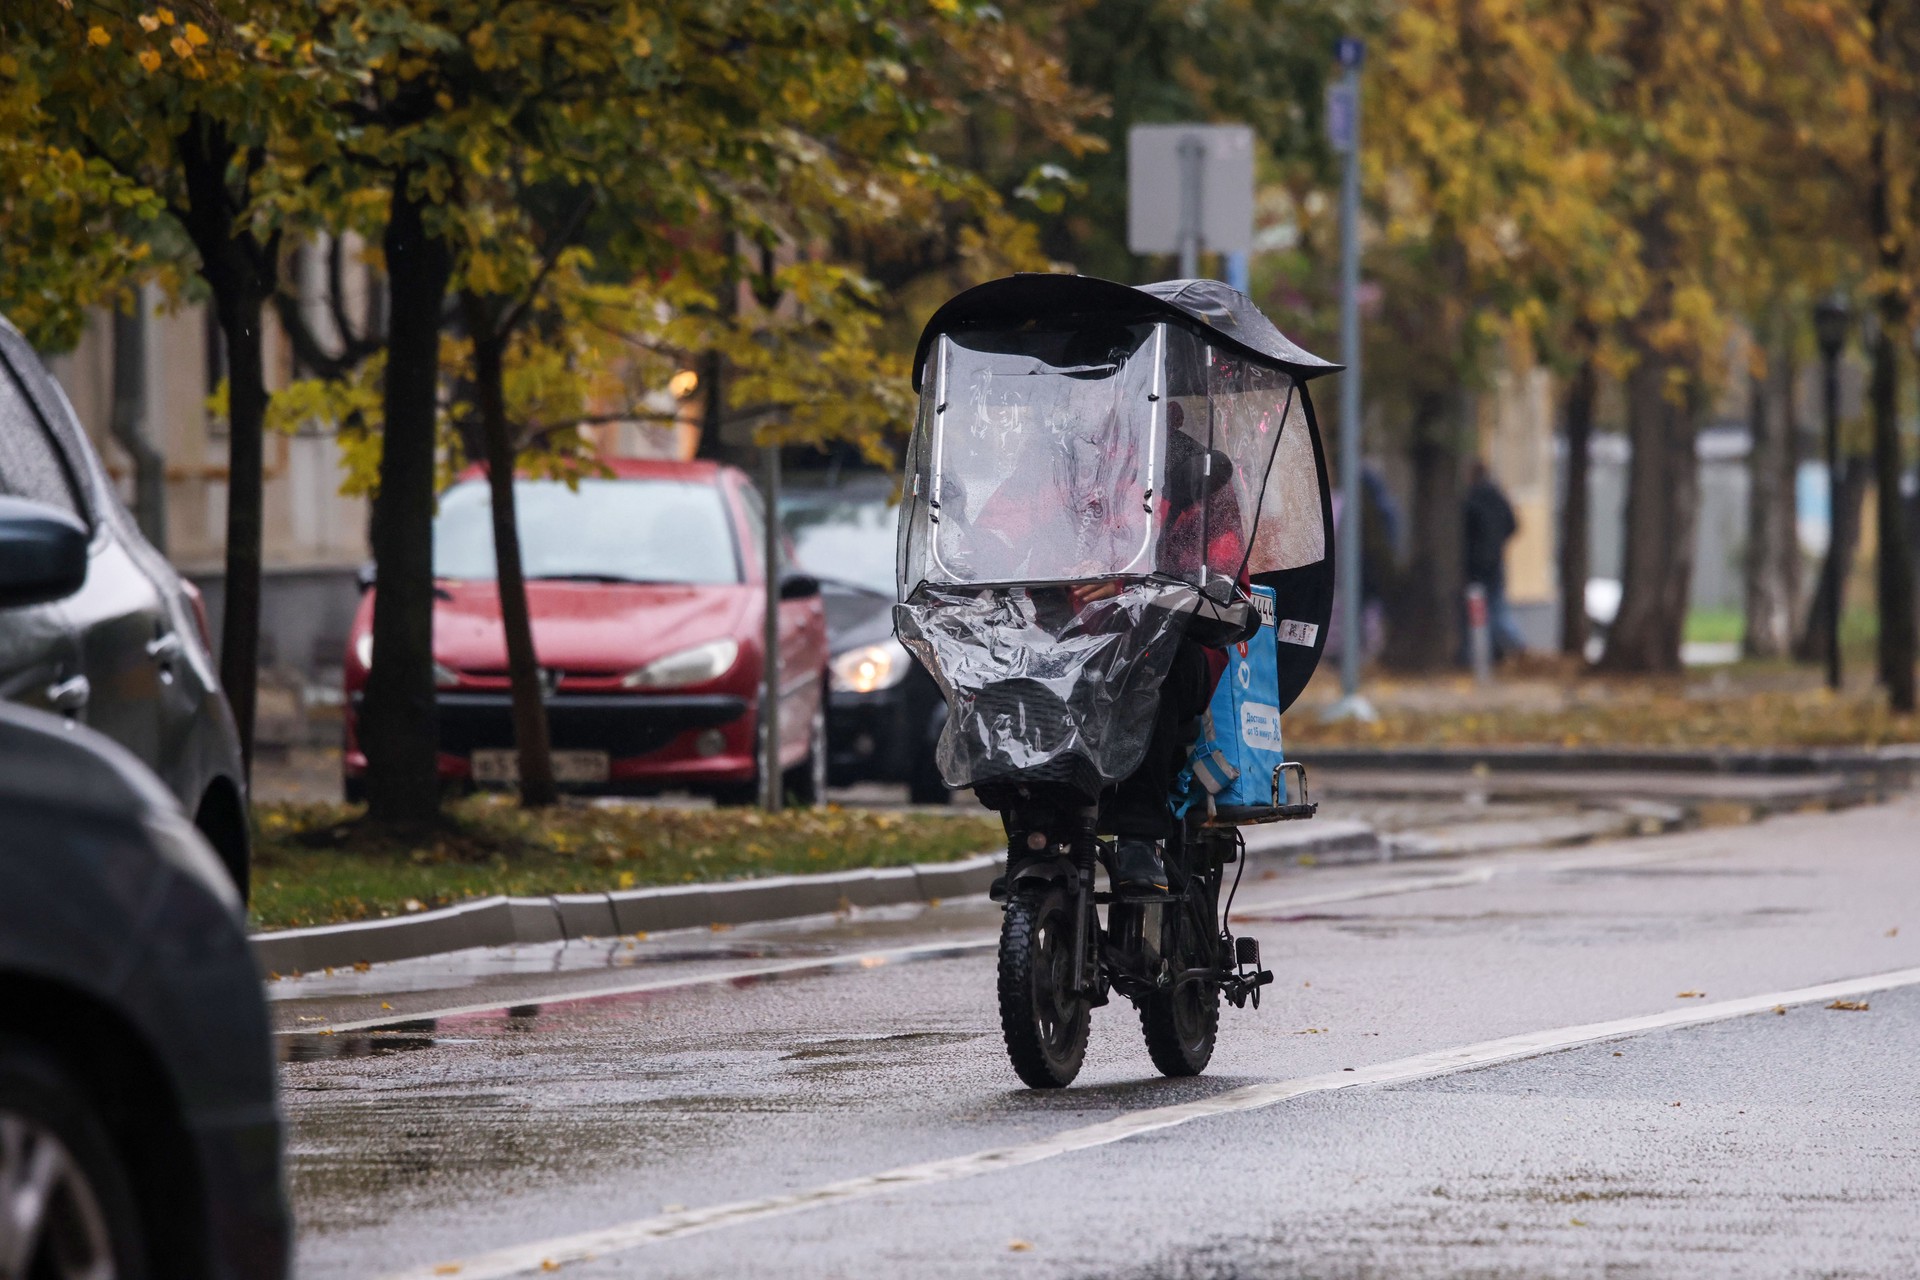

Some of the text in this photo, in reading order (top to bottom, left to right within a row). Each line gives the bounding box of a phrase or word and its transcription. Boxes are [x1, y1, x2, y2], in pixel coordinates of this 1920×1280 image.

[1246, 712, 1267, 724] Доставка
[1253, 726, 1259, 737] 15
[1259, 730, 1272, 740] минут
